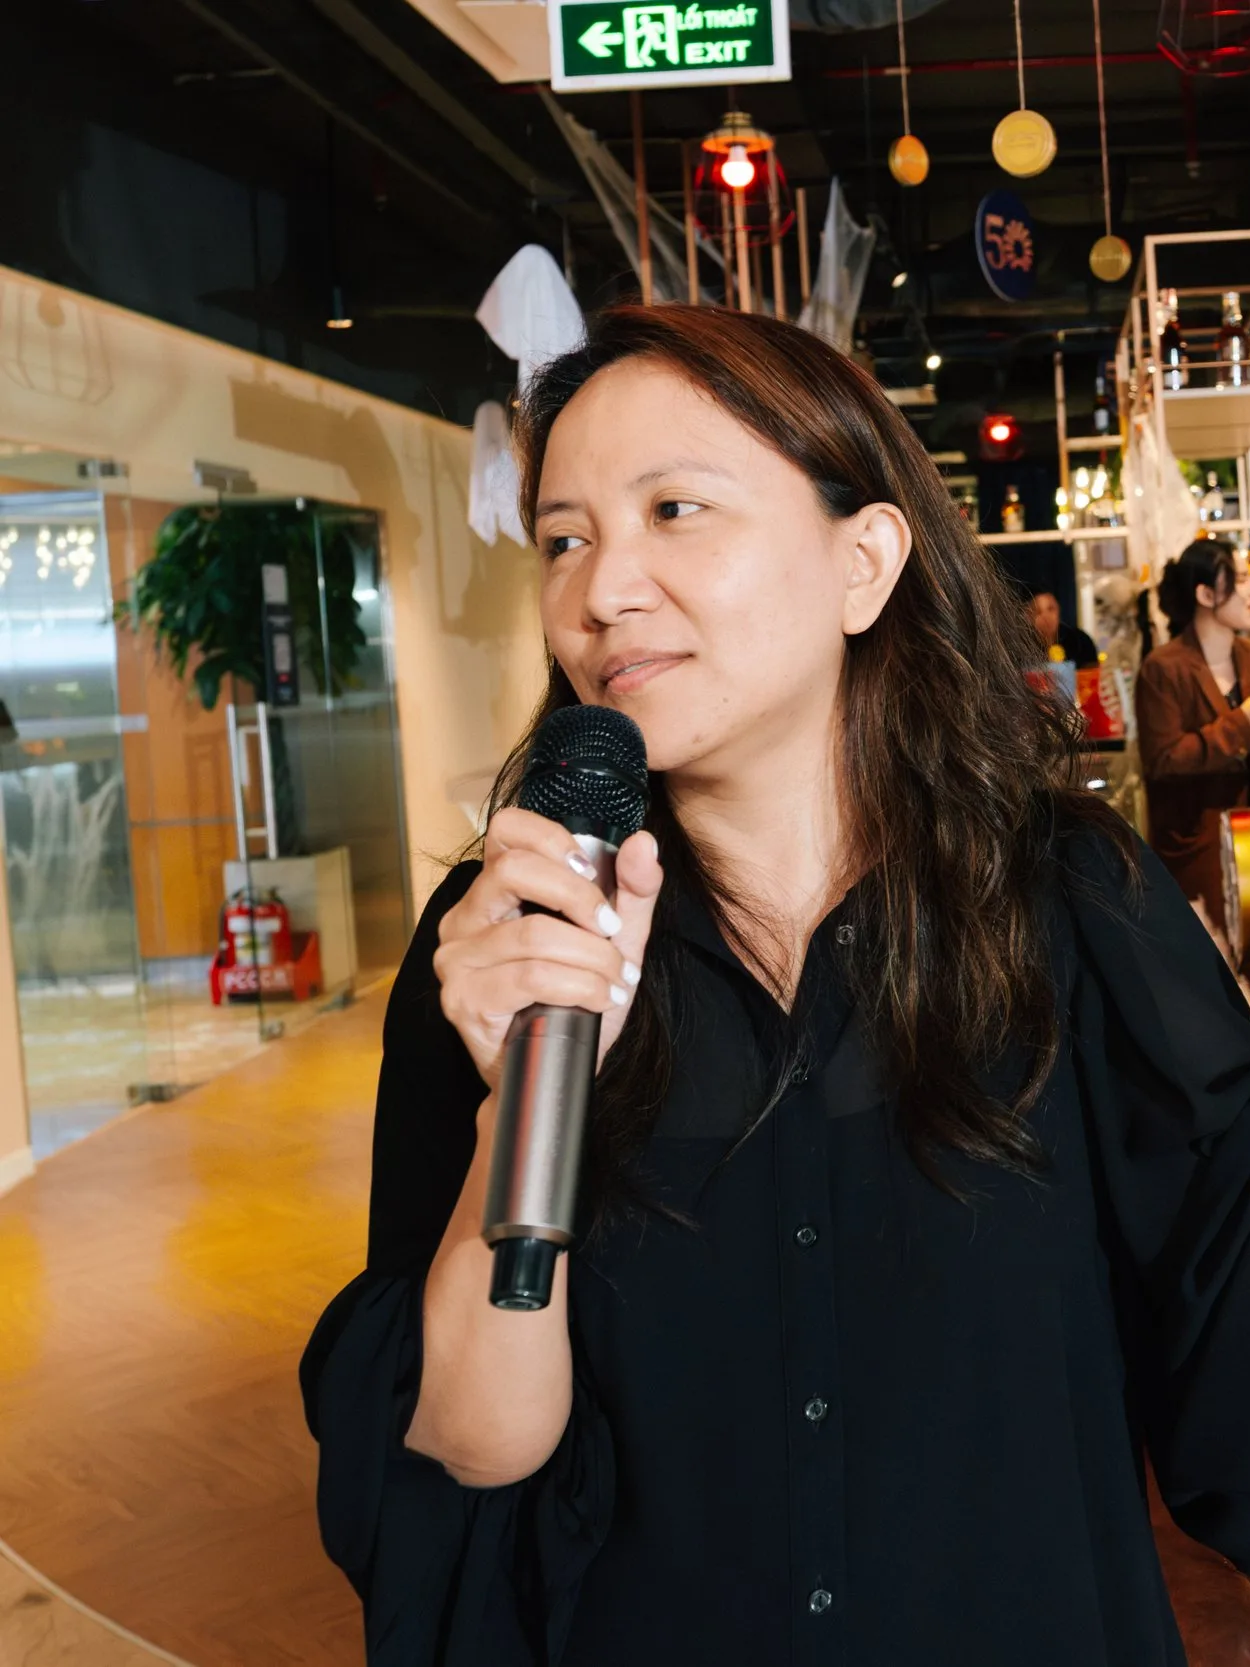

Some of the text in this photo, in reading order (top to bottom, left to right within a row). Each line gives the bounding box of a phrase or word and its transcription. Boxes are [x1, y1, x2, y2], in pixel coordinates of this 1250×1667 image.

[703, 3, 758, 29] THOÁT
[685, 40, 752, 64] EXIT
[985, 213, 1034, 272] 50
